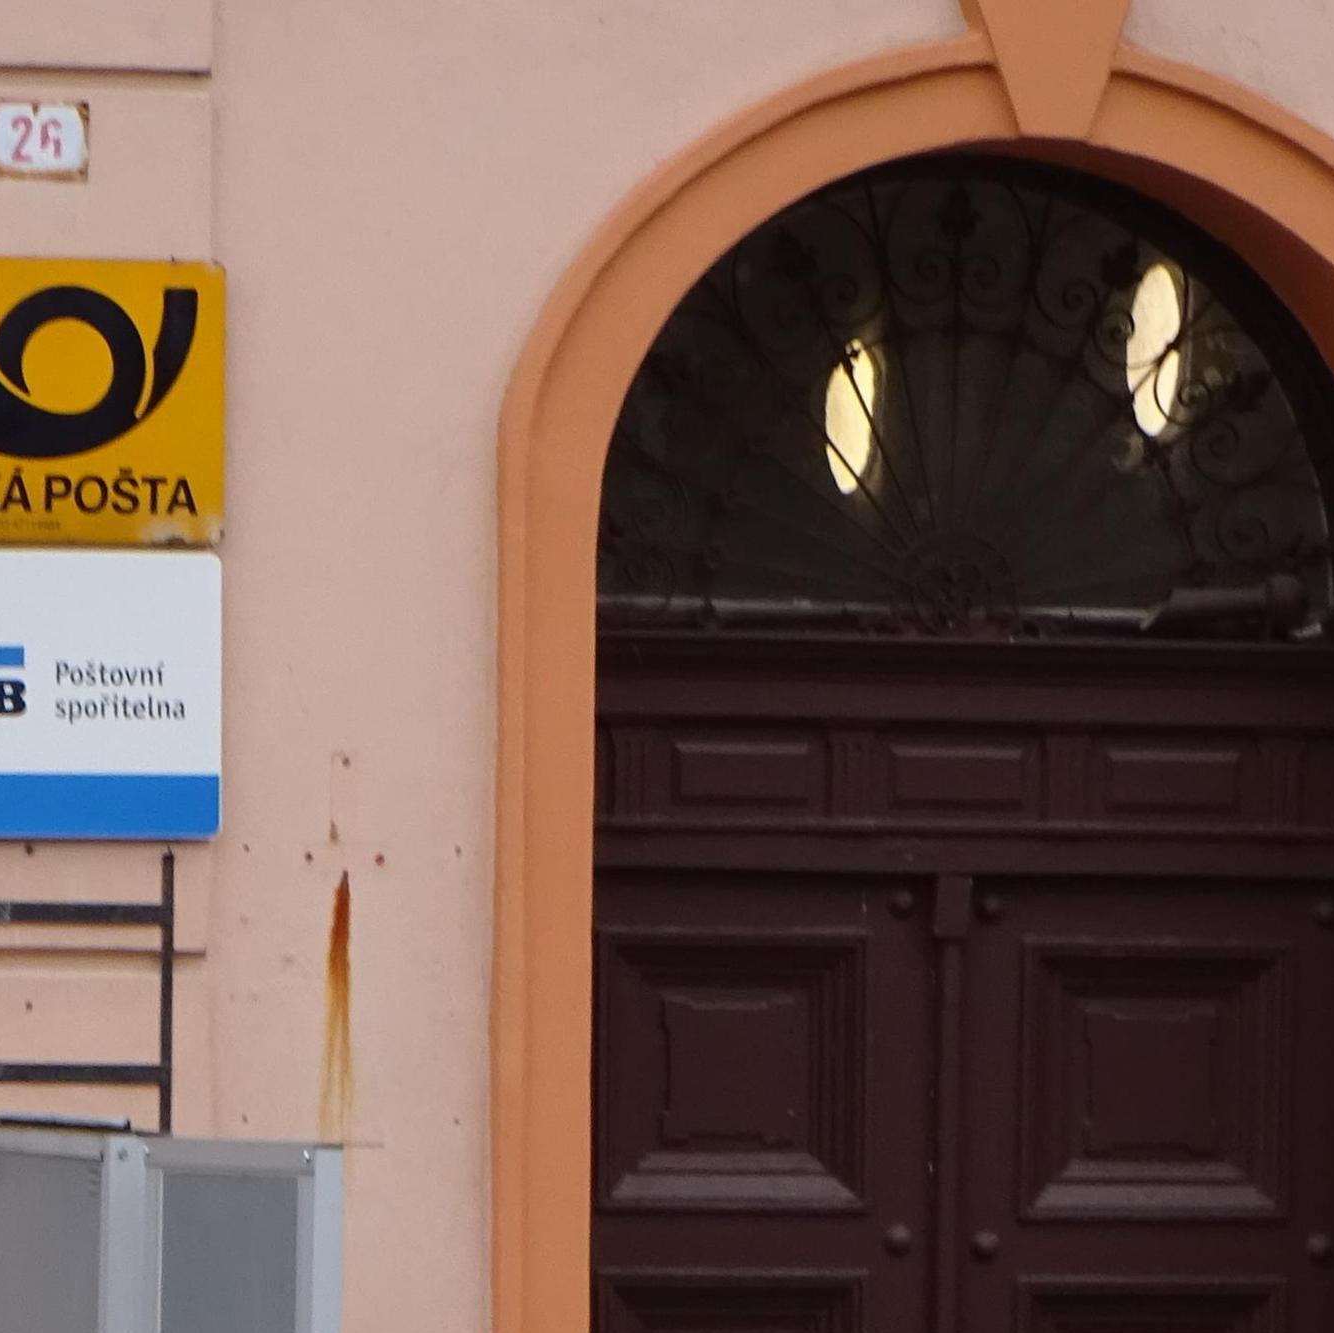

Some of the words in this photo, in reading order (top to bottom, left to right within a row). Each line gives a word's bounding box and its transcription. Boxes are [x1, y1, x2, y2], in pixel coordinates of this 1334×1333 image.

[44, 468, 197, 515] POŠTA
[55, 660, 165, 687] Poštovní
[55, 695, 186, 724] spořitelna
